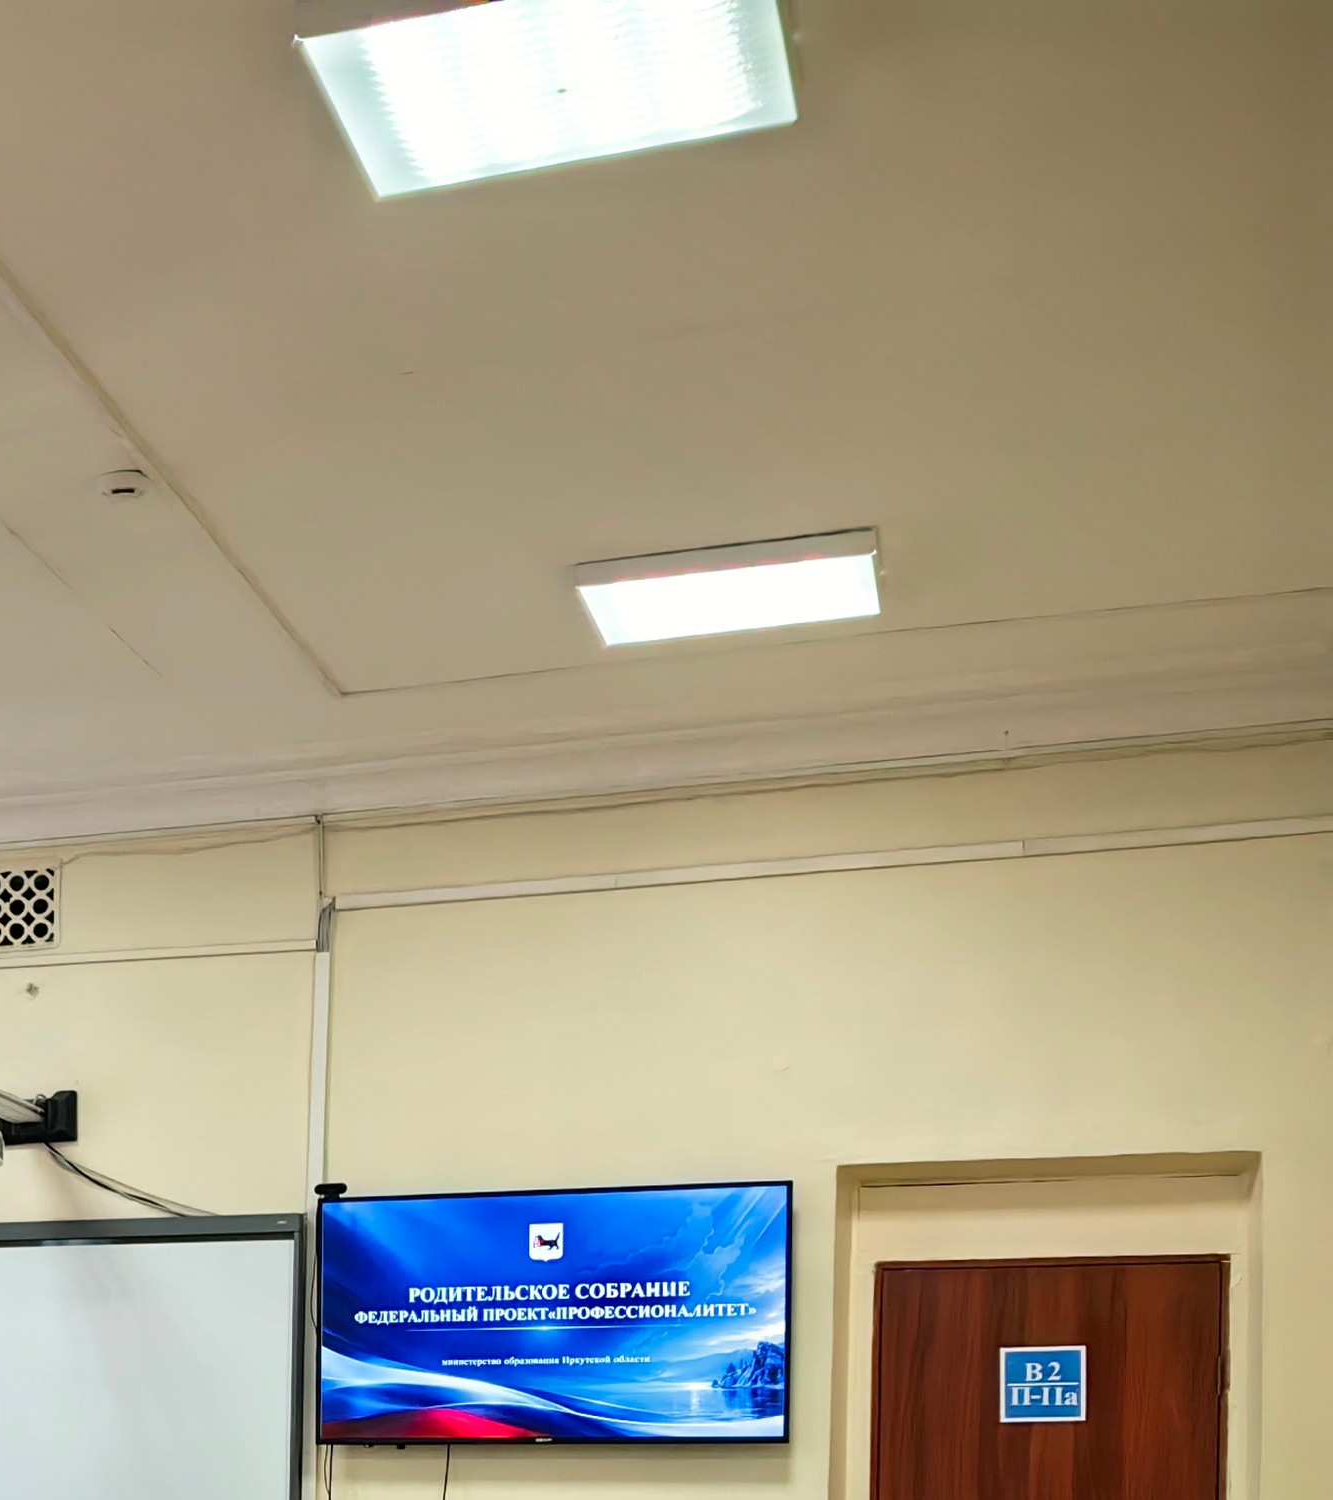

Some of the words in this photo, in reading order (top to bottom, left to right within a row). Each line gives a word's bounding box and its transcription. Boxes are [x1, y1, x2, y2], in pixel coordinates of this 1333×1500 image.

[408, 1284, 570, 1305] РОДИТЕЛЬСКОЕ
[575, 1281, 691, 1300] СОБРАНИЕ
[354, 1306, 478, 1326] ФЕДЕРАЛЬНЫЙ
[613, 1355, 651, 1363] области
